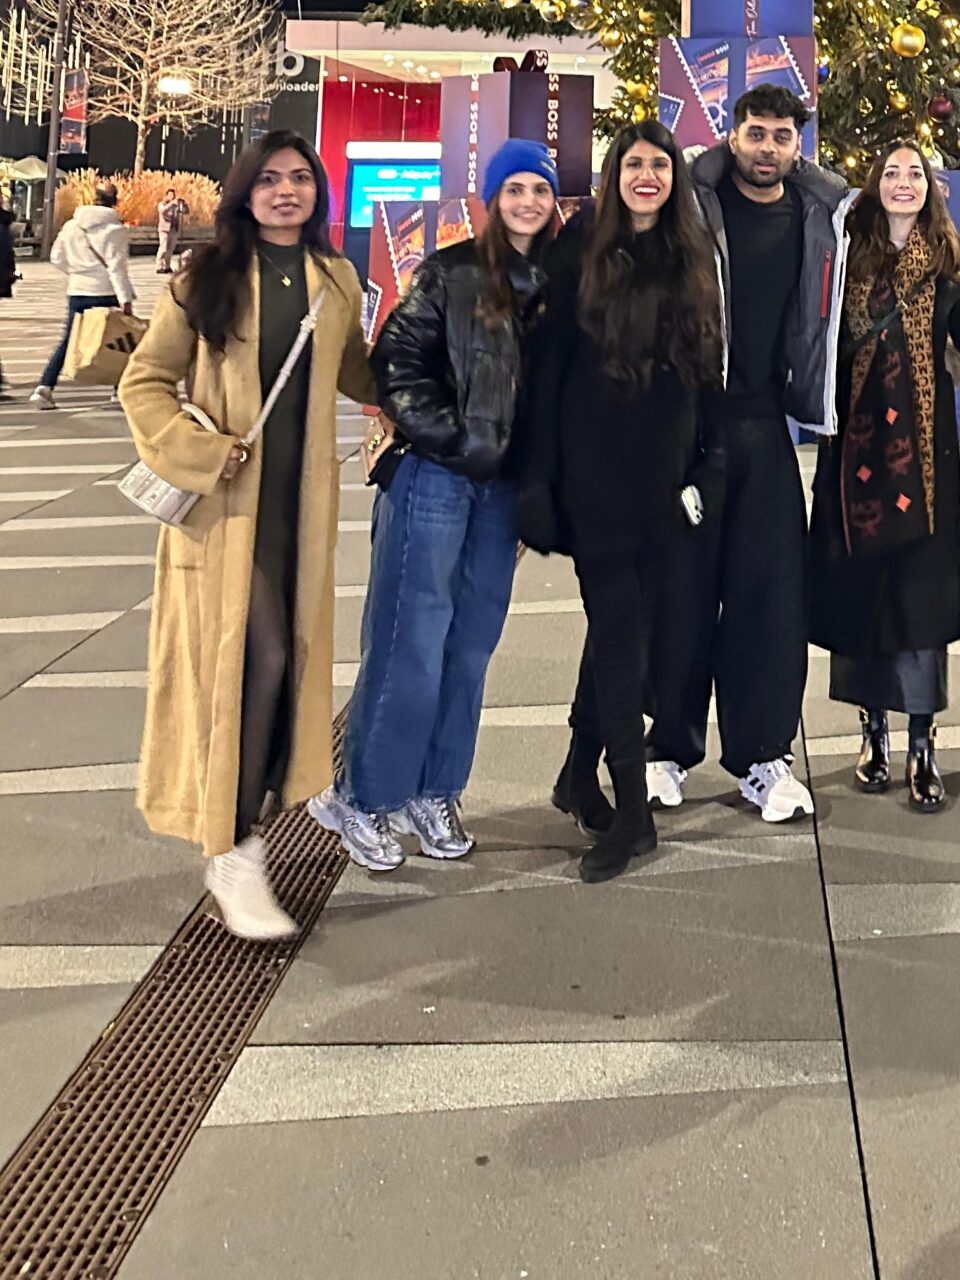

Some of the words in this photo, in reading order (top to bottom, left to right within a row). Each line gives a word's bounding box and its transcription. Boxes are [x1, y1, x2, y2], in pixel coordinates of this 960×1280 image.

[469, 102, 479, 144] BOSS
[547, 99, 559, 141] BOSS
[467, 150, 477, 193] BOSS
